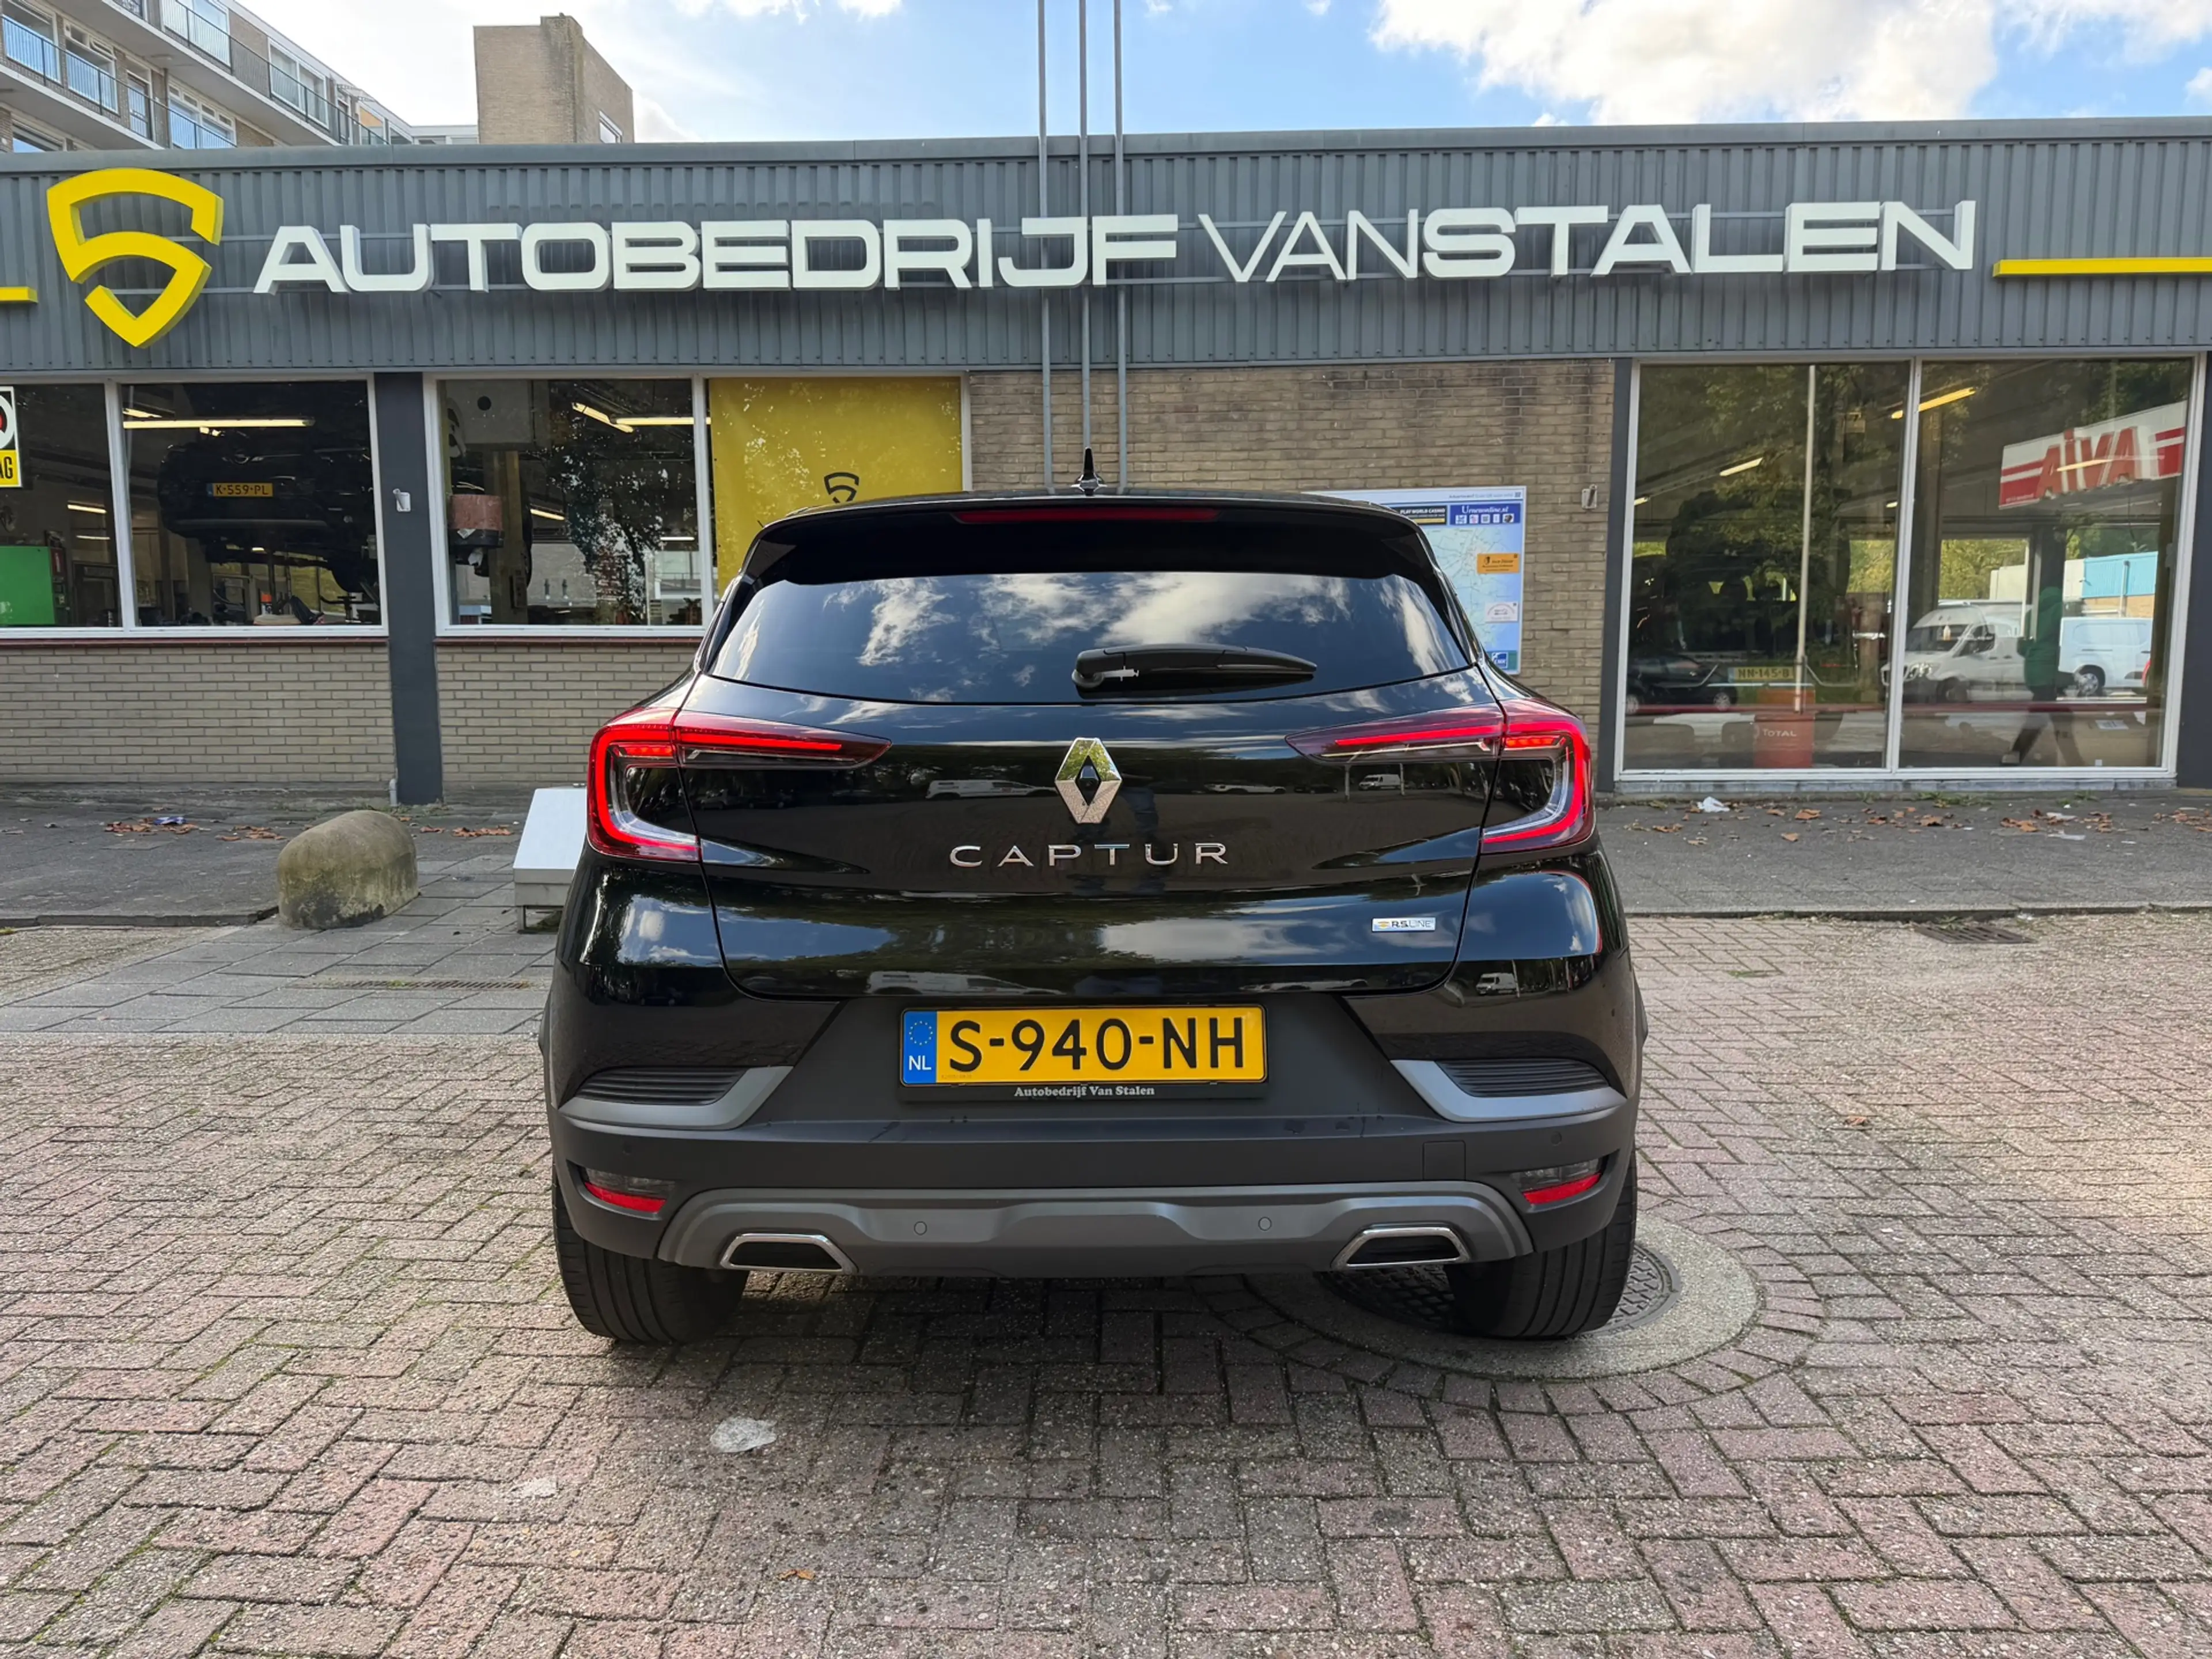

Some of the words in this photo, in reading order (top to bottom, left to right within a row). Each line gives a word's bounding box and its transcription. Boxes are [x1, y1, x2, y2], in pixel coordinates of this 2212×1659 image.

[253, 214, 1178, 295] AUTOBEDRIJF
[949, 842, 1228, 867] CAPTUR
[949, 1017, 1245, 1073] S-940-NH
[908, 1055, 932, 1070] NL
[1014, 1086, 1088, 1098] Autobedrijf
[1089, 1086, 1113, 1096] Van
[1115, 1085, 1156, 1096] Stalen
